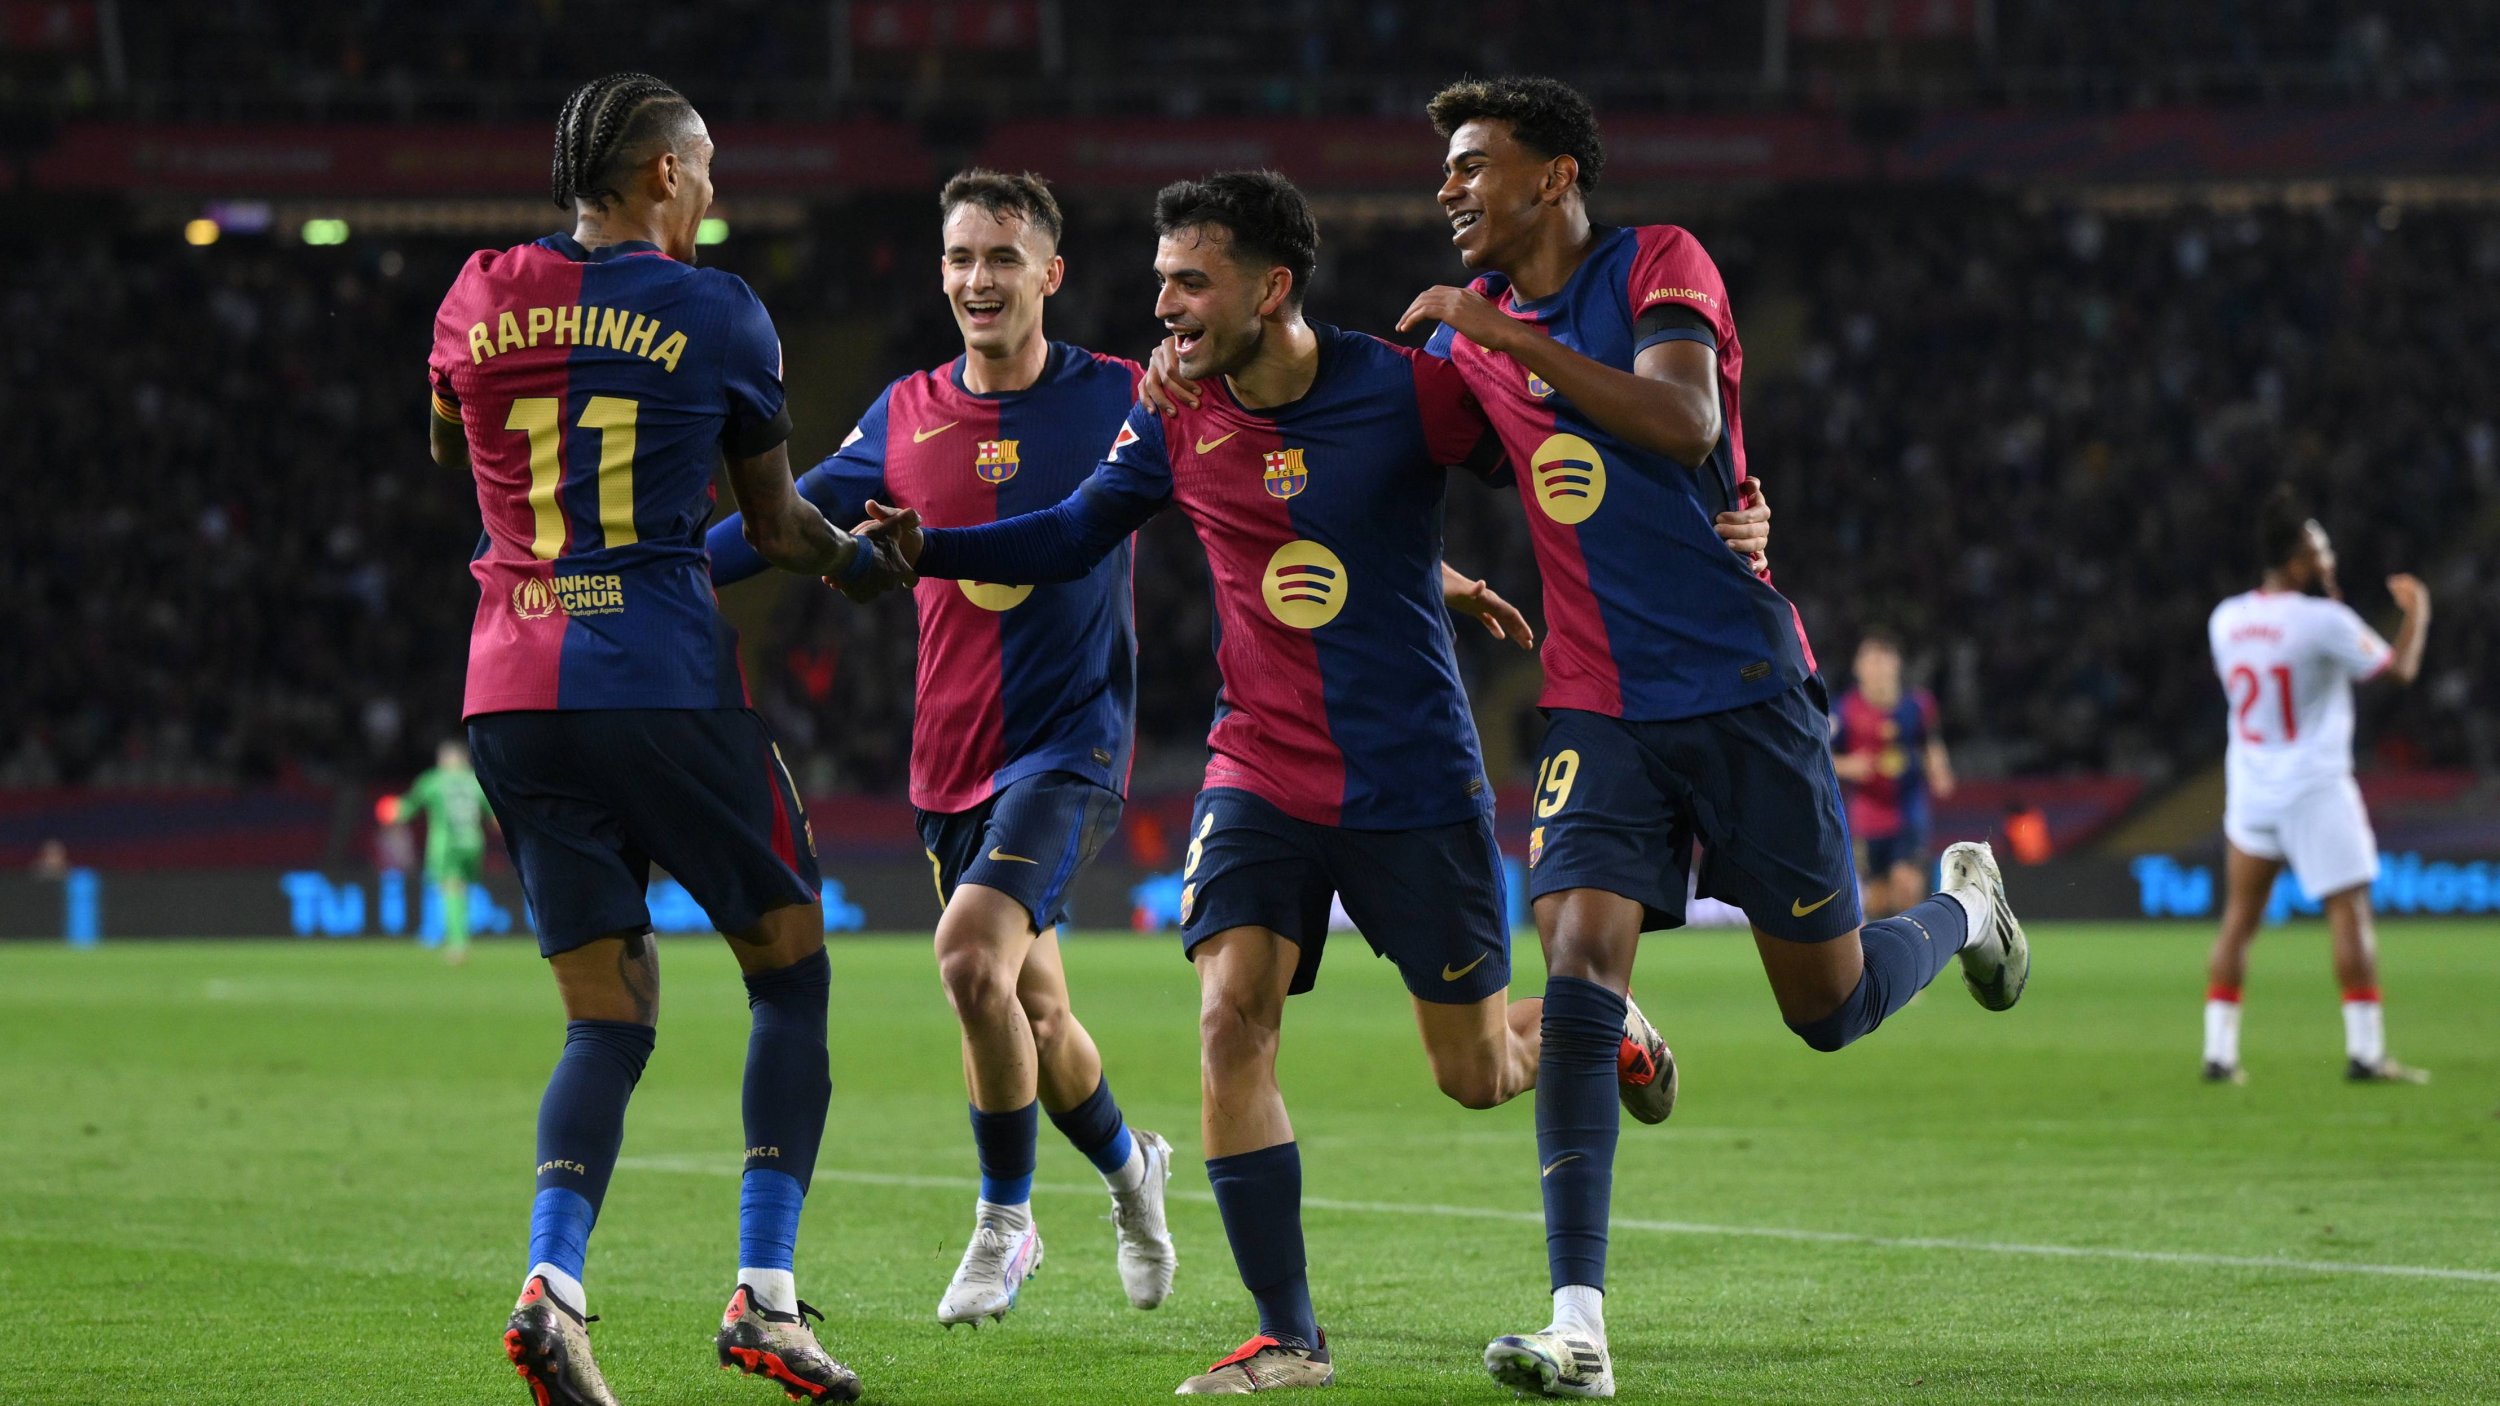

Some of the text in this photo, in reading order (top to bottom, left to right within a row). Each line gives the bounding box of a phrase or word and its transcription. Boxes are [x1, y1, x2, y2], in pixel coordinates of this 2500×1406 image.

[468, 305, 688, 374] RAPHINHA
[504, 396, 639, 561] 11
[549, 575, 622, 595] UNHCR
[572, 609, 599, 617] Refugee
[600, 606, 625, 615] Agency
[2229, 664, 2299, 744] 21
[1532, 749, 1580, 819] 19
[281, 870, 366, 935] Tu
[2131, 854, 2213, 915] Tu
